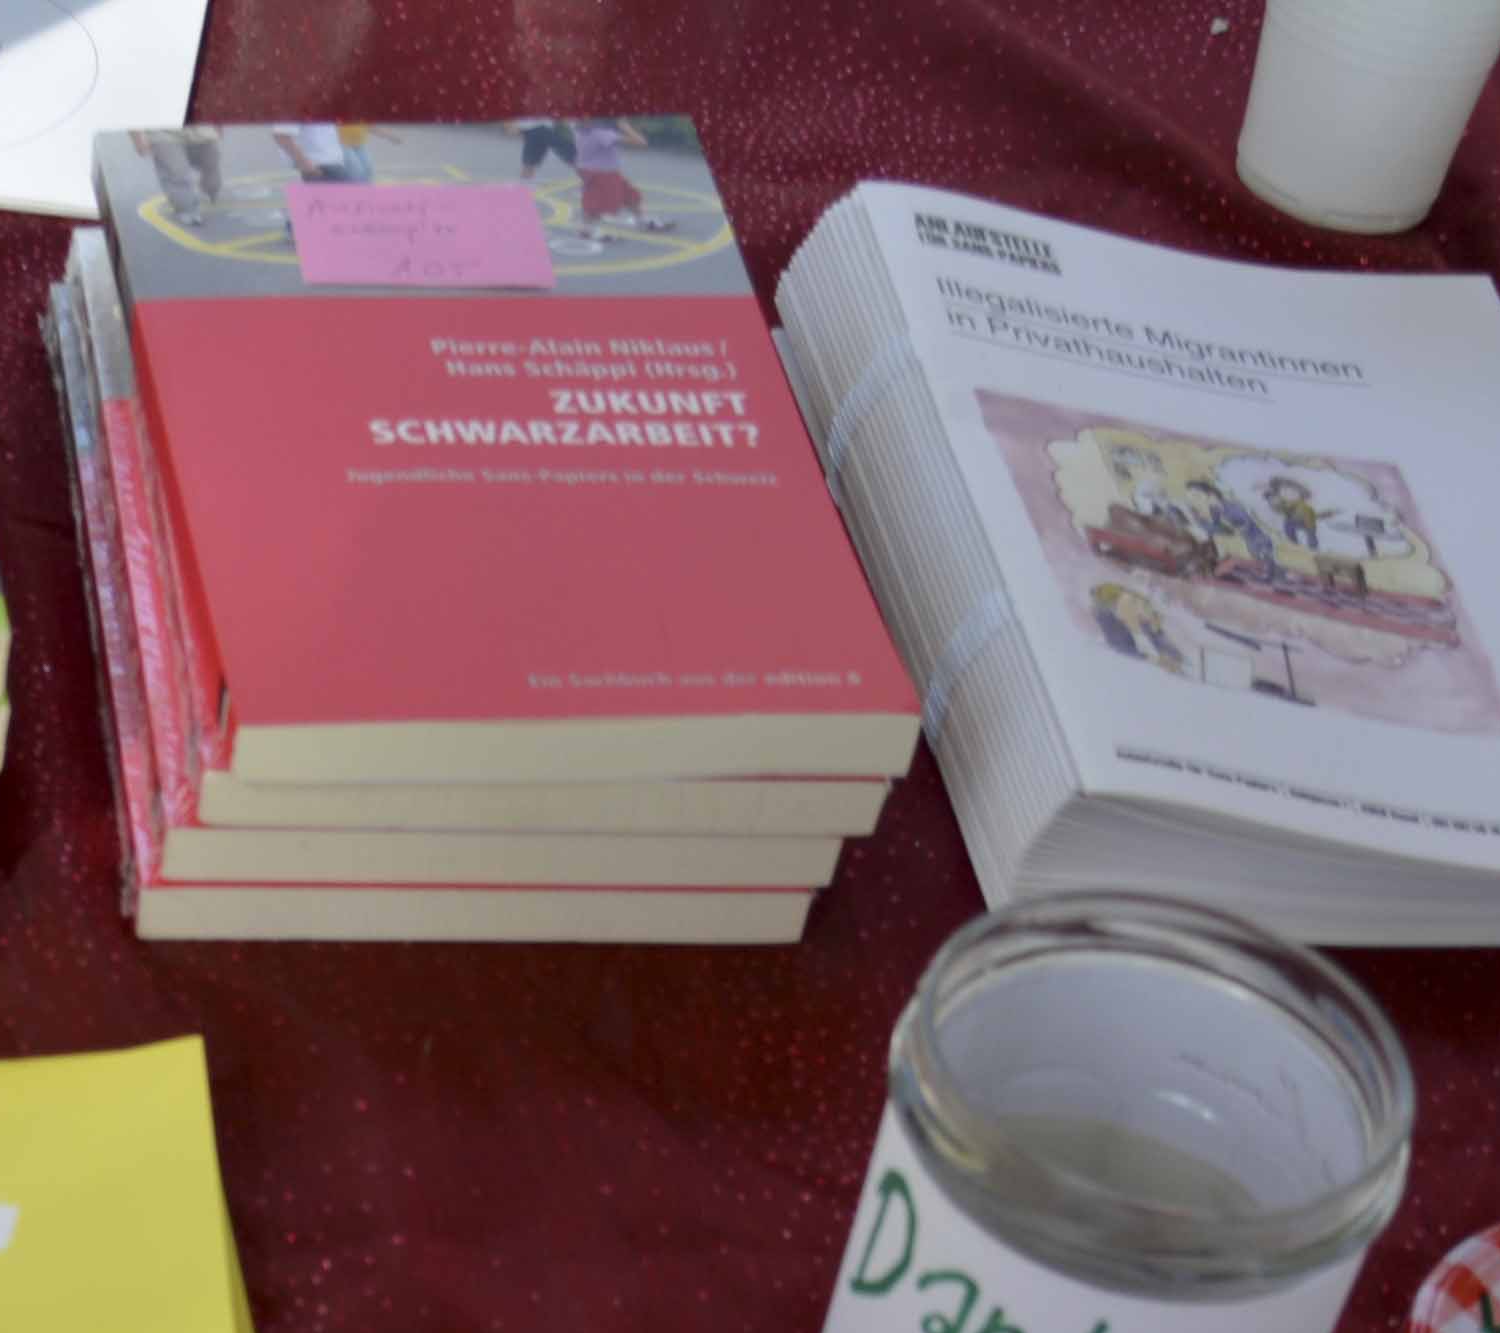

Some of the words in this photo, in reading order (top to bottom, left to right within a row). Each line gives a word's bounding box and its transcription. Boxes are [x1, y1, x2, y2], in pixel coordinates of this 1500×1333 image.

[936, 276, 1136, 340] Illegalisierte
[1142, 324, 1366, 381] Migrantinnen
[946, 309, 976, 332] in
[986, 316, 1269, 395] Privathaushalten
[446, 360, 517, 378] Hans
[550, 389, 748, 415] ZUKUNFT
[368, 418, 760, 448] SCHWARZARBEIT?
